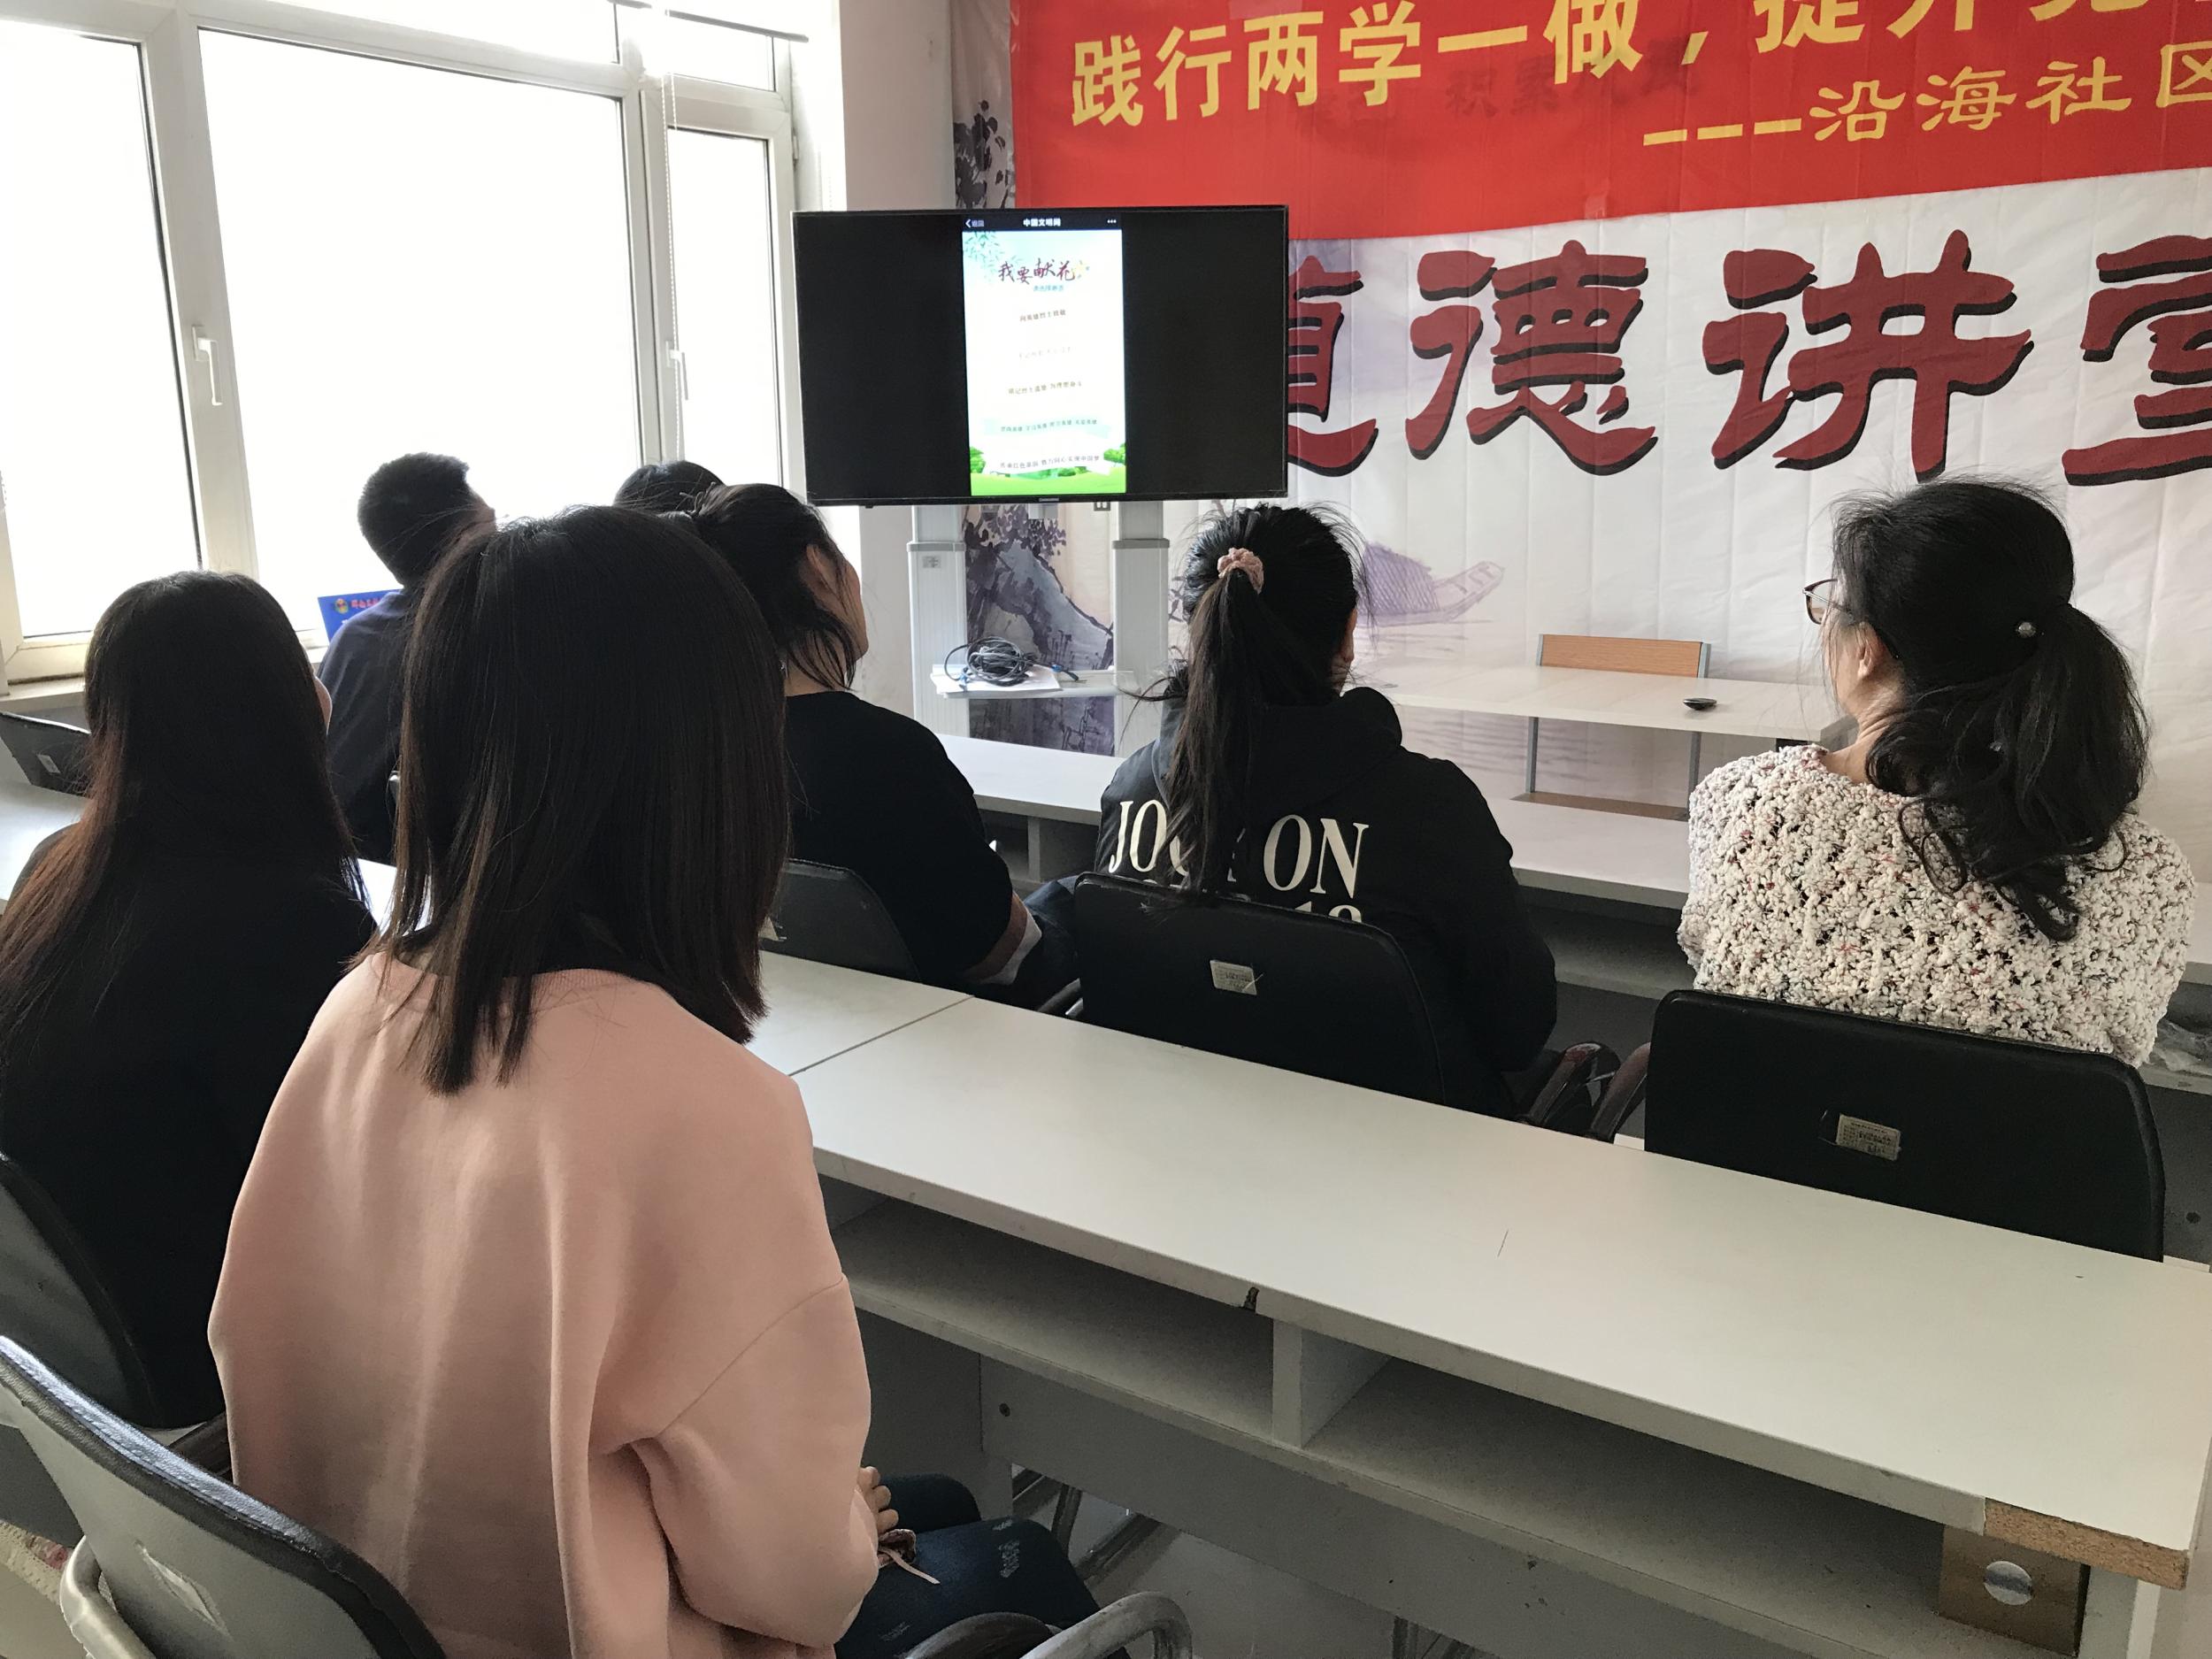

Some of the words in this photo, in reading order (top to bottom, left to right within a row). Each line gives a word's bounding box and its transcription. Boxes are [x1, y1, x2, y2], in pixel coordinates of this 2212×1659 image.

[1023, 218, 1062, 227] 中国文明网
[998, 257, 1076, 285] 我要献花
